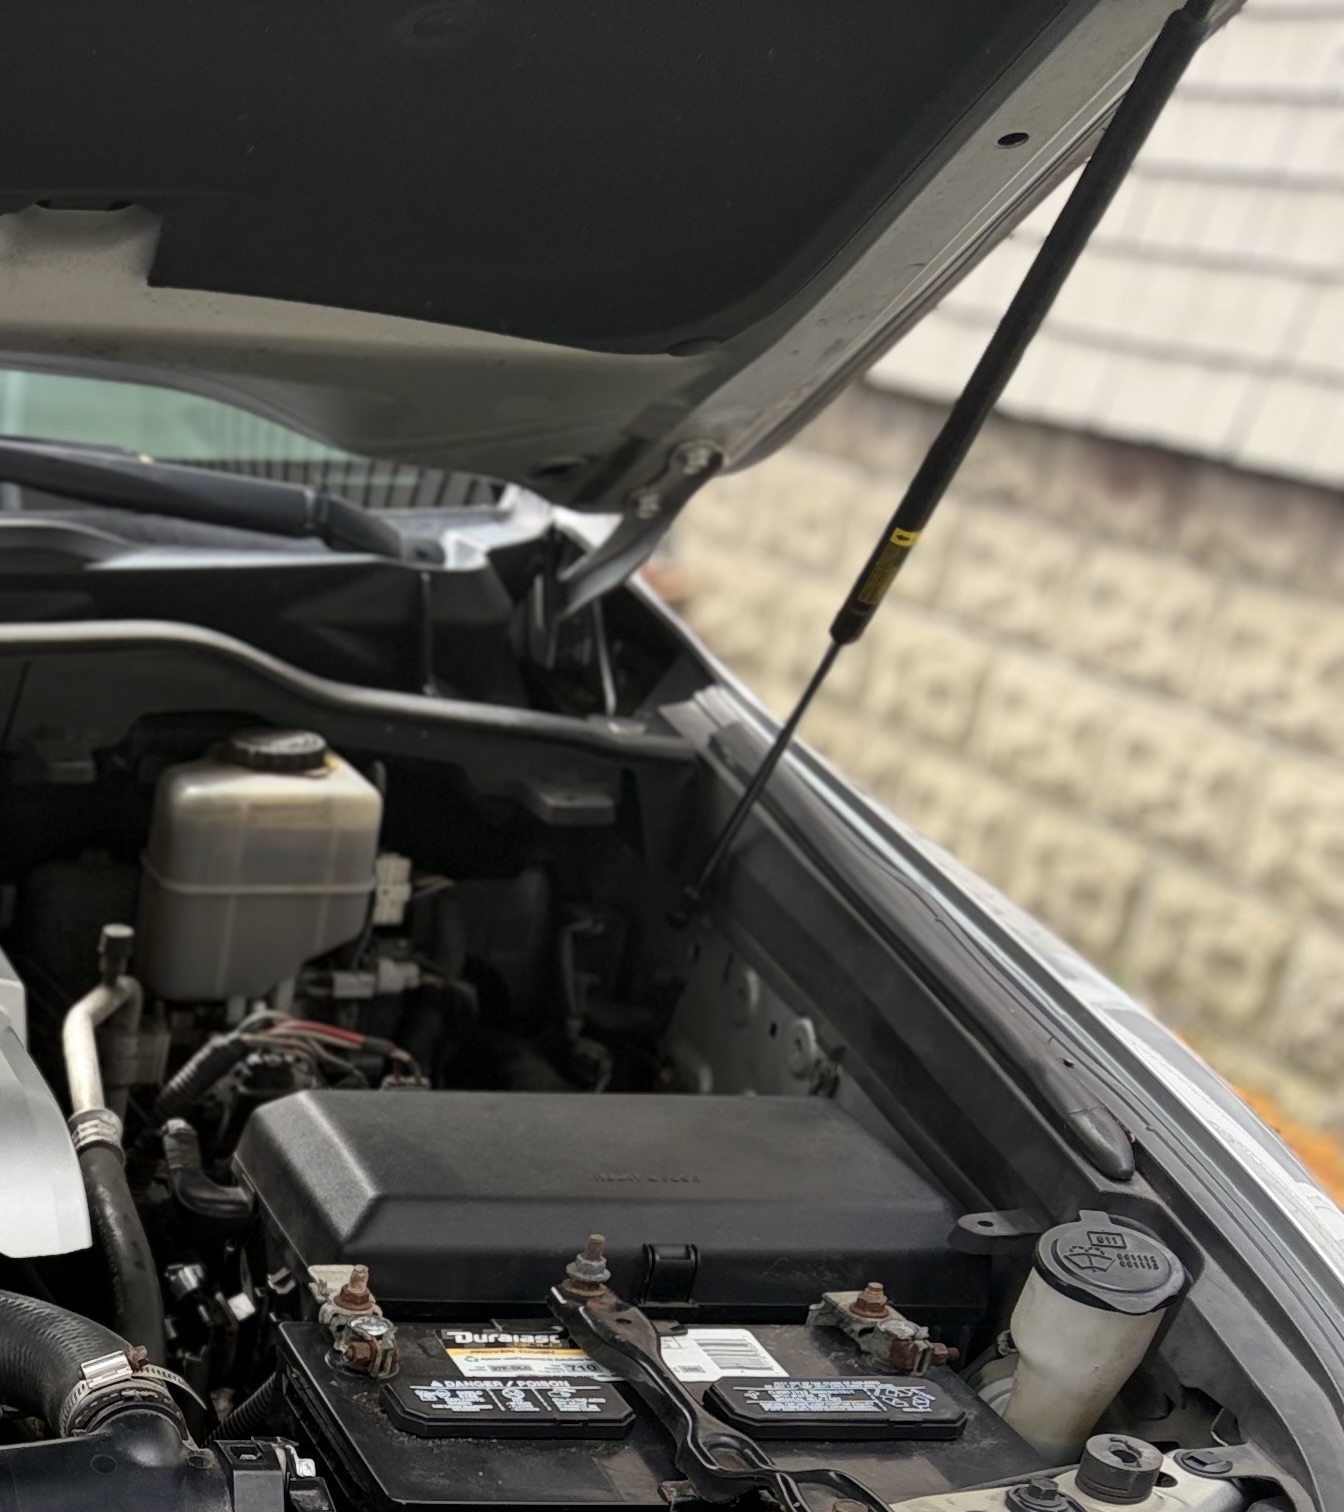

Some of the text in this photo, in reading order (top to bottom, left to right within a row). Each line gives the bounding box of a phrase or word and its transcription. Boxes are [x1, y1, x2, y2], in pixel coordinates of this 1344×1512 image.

[446, 1331, 561, 1344] Duralast
[566, 1363, 599, 1373] 710
[443, 1380, 504, 1388] DANGER
[516, 1380, 571, 1388] POISON
